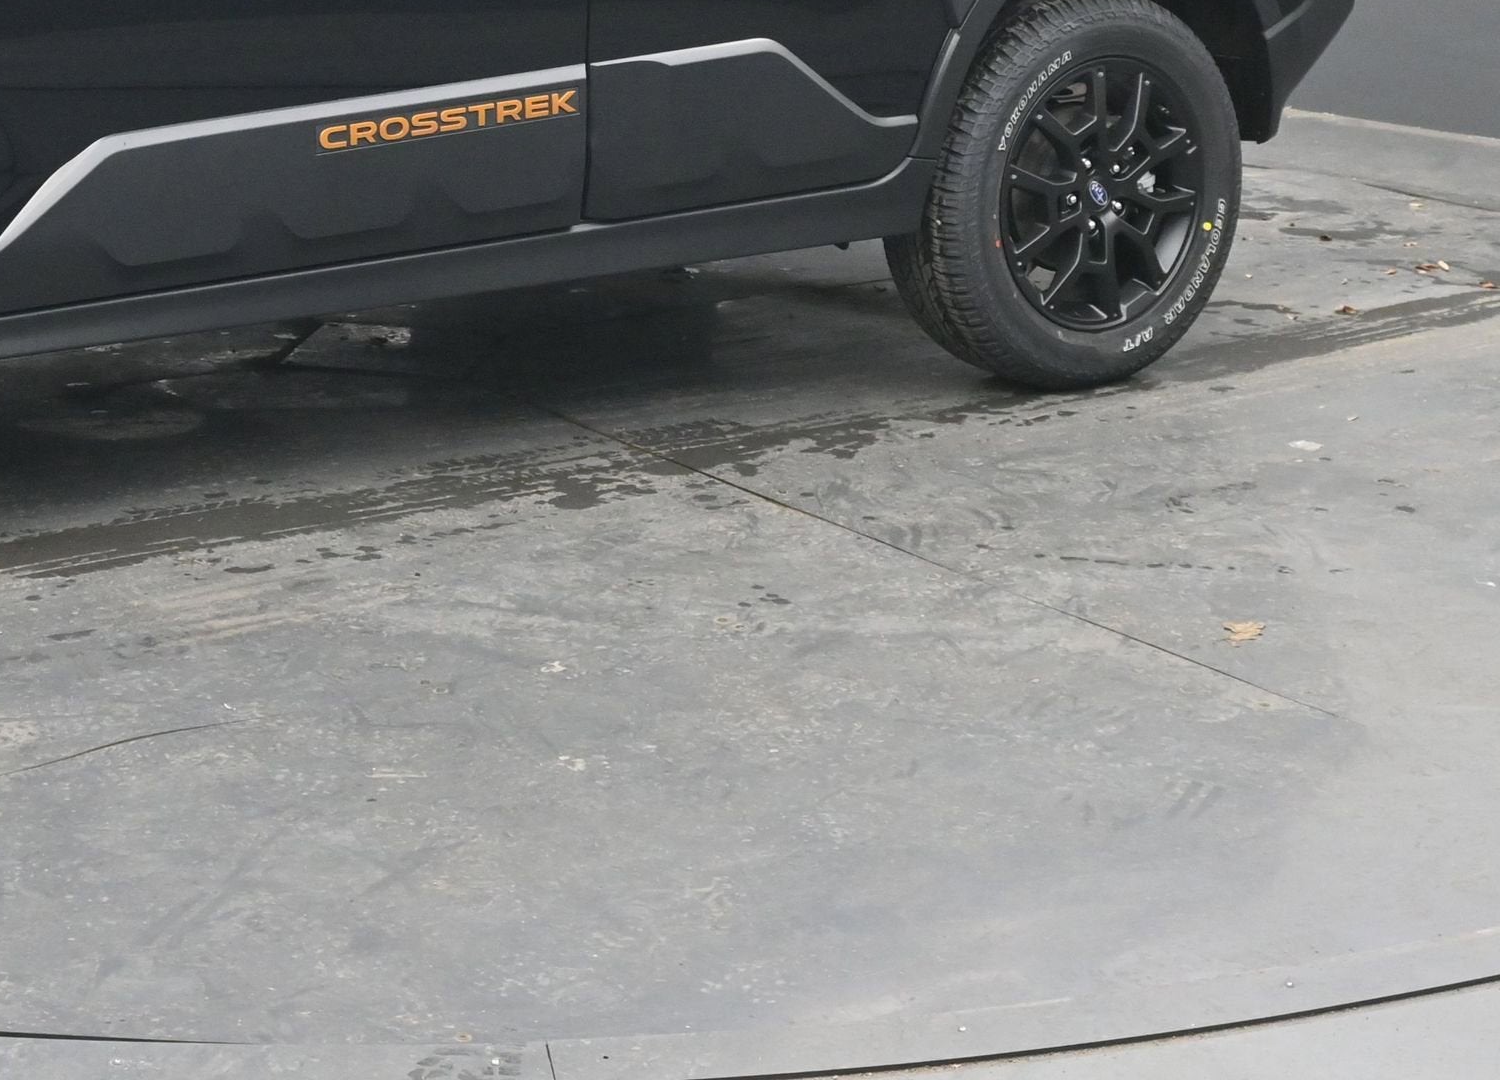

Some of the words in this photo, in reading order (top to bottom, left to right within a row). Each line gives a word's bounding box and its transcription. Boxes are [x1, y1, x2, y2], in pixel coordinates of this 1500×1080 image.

[318, 90, 578, 150] CROSSTREK
[998, 50, 1072, 152] YOKOHAMA
[1163, 198, 1227, 325] GEOLANDAR
[1122, 326, 1153, 352] A/T
